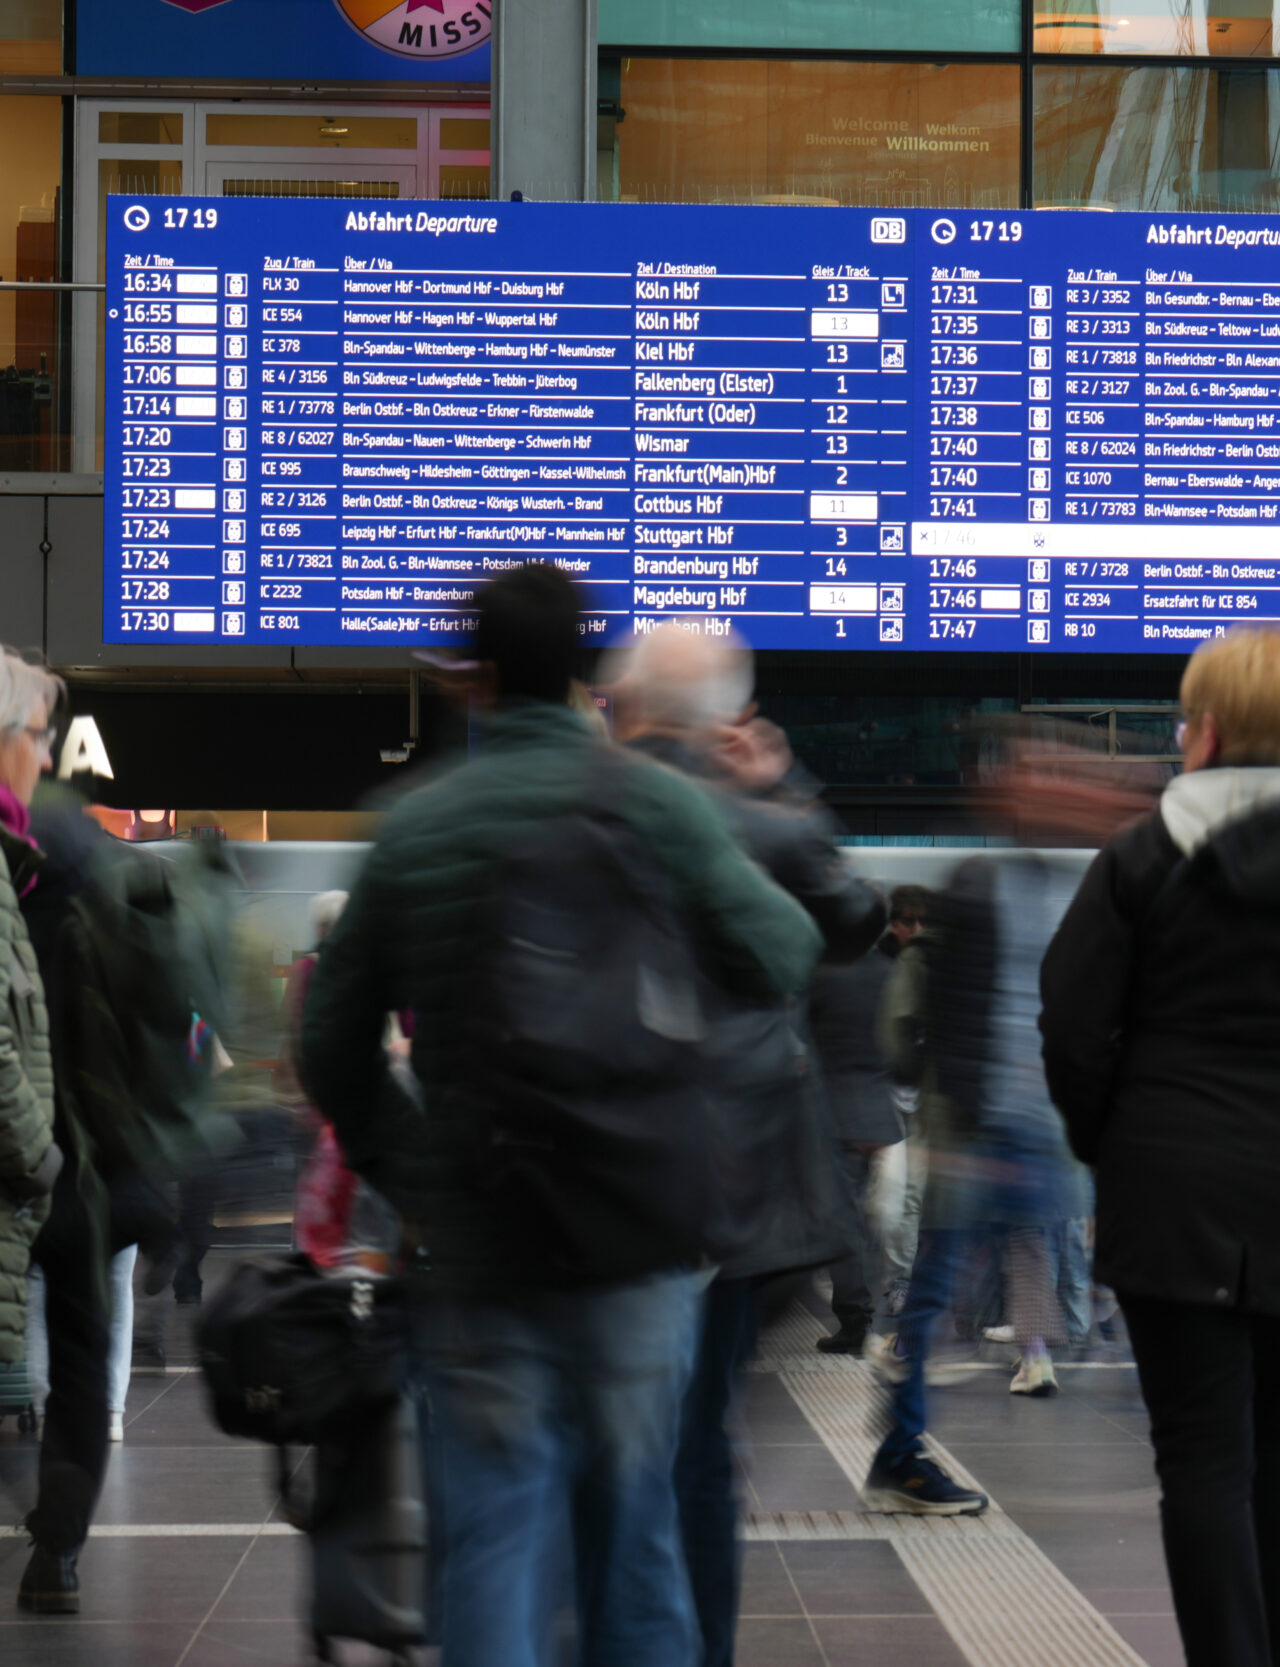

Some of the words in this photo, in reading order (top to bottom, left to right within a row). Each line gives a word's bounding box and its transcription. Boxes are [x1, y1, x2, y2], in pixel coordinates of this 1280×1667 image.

[833, 117, 909, 132] Welcome
[926, 123, 981, 136] Welkom
[805, 133, 878, 146] Bienvenue
[886, 136, 990, 152] Willkommen
[345, 211, 413, 233] Abfahrt
[414, 212, 498, 237] Departure
[874, 221, 903, 241] DB
[1146, 224, 1212, 246] Abfahrt
[124, 273, 172, 292] 16:34
[262, 277, 282, 291] FLX
[284, 277, 300, 292] 30
[635, 280, 670, 300] Köln
[673, 281, 700, 300] Hbf
[931, 285, 978, 305] 17:31
[121, 303, 172, 323] 16:55
[262, 308, 278, 322] ICE
[280, 308, 303, 322] 554
[635, 311, 670, 330] Köln
[673, 311, 700, 331] Hbf
[931, 315, 978, 335] 17:35
[123, 334, 172, 354] 16:58
[262, 338, 276, 353] EC
[278, 338, 301, 353] 378
[635, 341, 664, 361] Kiel
[668, 342, 695, 361] Hbf
[931, 346, 978, 365] 17:36
[123, 365, 172, 385] 17:06
[635, 372, 716, 396] Falkenberg
[719, 372, 774, 395] (Elster)
[930, 376, 978, 396] 17:37
[123, 396, 171, 416] 17:14
[634, 402, 704, 423] Frankfurt
[708, 402, 756, 426] (Oder)
[930, 406, 978, 426] 17:38
[1065, 410, 1081, 425] ICE
[1083, 410, 1105, 425] 506
[122, 427, 171, 447] 17:20
[634, 433, 690, 453] Wismar
[930, 437, 978, 457] 17:40
[122, 457, 171, 477] 17:23
[261, 461, 277, 476] ICE
[279, 461, 302, 476] 995
[342, 463, 411, 481] Braunschweig
[419, 464, 472, 478] Hildesheim
[481, 465, 531, 482] Göttingen
[539, 465, 627, 480] Kassel-Wilhelmsh
[634, 463, 776, 487] Frankfurt(Main)Hbf
[930, 467, 978, 487] 17:40
[1065, 471, 1081, 485] ICE
[1082, 471, 1112, 486] 1070
[1144, 472, 1179, 487] Bernau
[1187, 473, 1244, 488] Eberswalde
[122, 488, 171, 508] 17:23
[634, 494, 693, 514] Cottbus
[696, 495, 723, 514] Hbf
[930, 497, 977, 518] 17:41
[121, 519, 170, 539] 17:24
[634, 524, 703, 549] Stuttgart
[707, 525, 734, 545] Hbf
[121, 550, 170, 570] 17:24
[634, 555, 729, 580] Brandenburg
[732, 556, 759, 576] Hbf
[929, 558, 977, 578] 17:46
[121, 581, 170, 601] 17:28
[260, 584, 270, 599] IC
[272, 584, 302, 599] 2232
[633, 586, 717, 610] Magdeburg
[720, 587, 747, 606] Hbf
[929, 589, 977, 609] 17:46
[1143, 594, 1199, 609] Ersatzfahrt
[1201, 594, 1217, 609] für
[1218, 595, 1234, 609] ICE
[1235, 595, 1258, 609] 854
[121, 612, 170, 632] 17:30
[260, 615, 276, 629] ICE
[277, 615, 300, 630] 801
[704, 617, 731, 637] Hbf
[929, 619, 977, 639] 17:47
